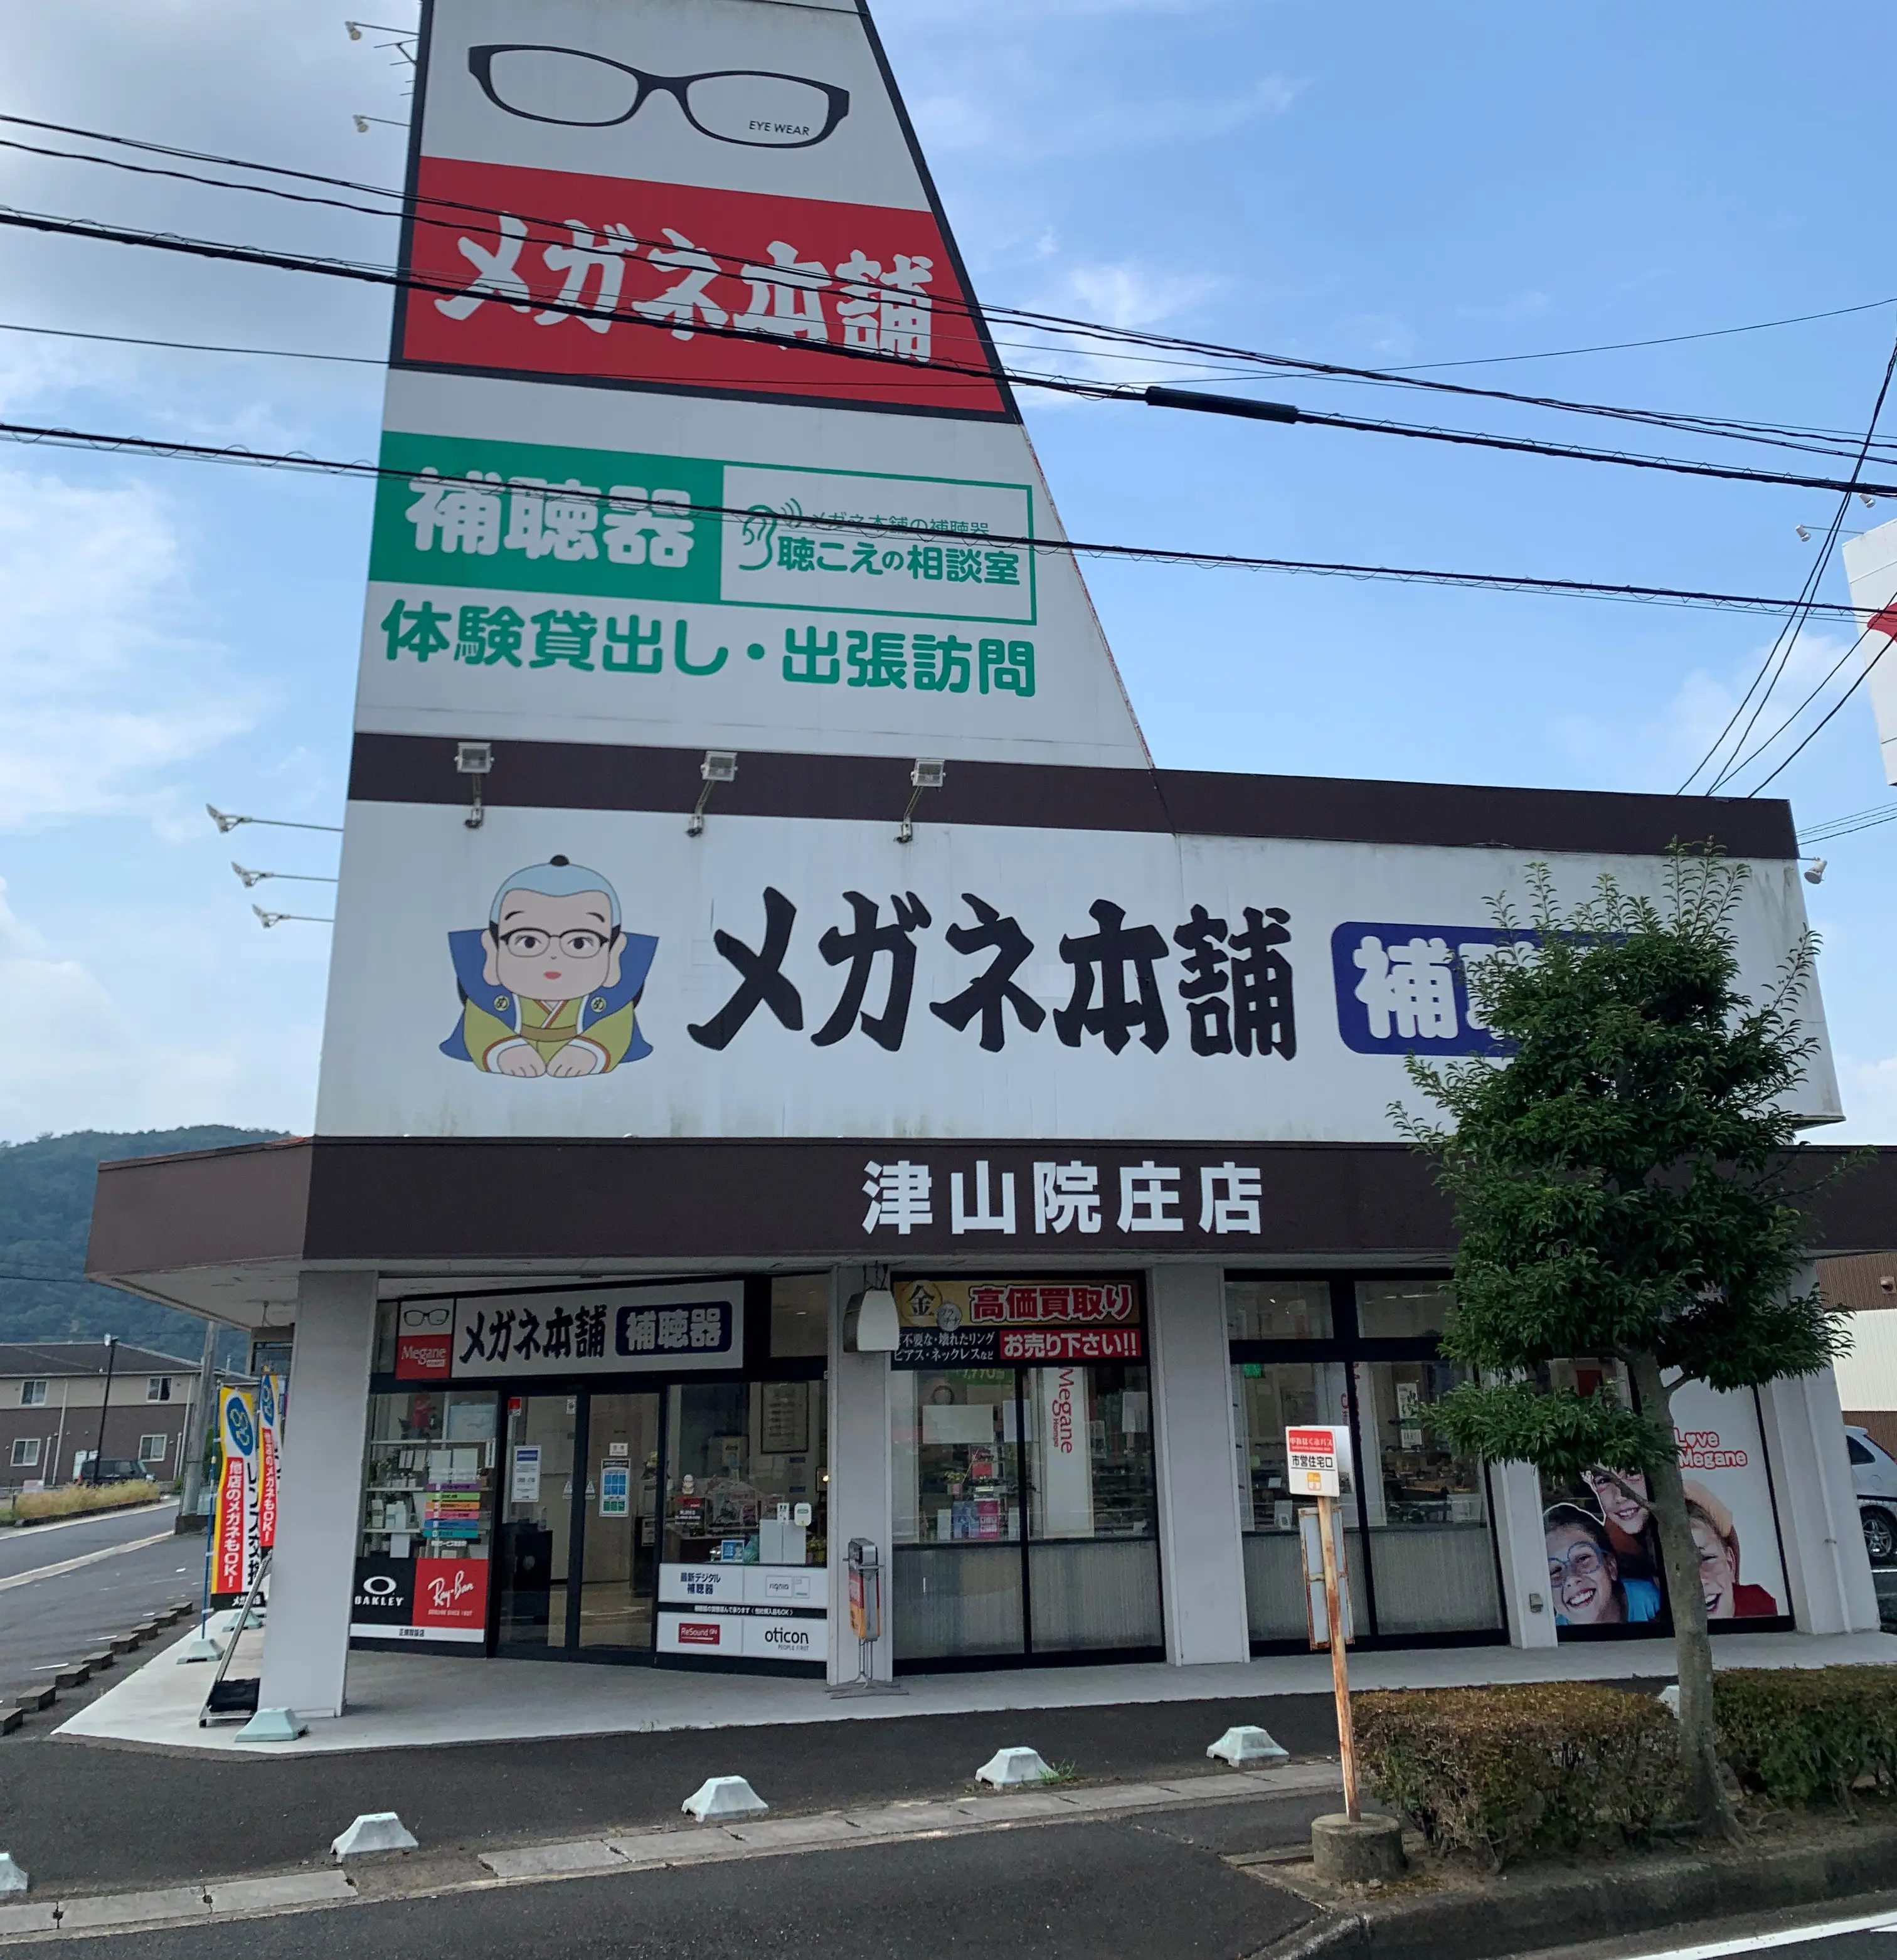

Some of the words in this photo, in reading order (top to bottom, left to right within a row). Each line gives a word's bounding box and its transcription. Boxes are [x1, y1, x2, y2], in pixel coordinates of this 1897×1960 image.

[749, 120, 771, 132] EYE
[774, 123, 810, 136] WEAR
[434, 211, 932, 363] メガネ本舗
[405, 467, 694, 568] 補聴器
[777, 534, 1020, 585] 聴こえの相談室
[380, 598, 1036, 697] 体験貸出し・出張訪問
[687, 887, 1297, 1061] メガネ本舗
[861, 1160, 1263, 1235] 津山院庄店
[908, 1284, 935, 1317] 金
[969, 1285, 1133, 1322] 高価買取り
[459, 1303, 608, 1364] メガネ本舗
[626, 1308, 722, 1350] 補聴器
[401, 1345, 447, 1365] Megane
[1051, 1369, 1075, 1454] Megane
[1292, 1455, 1334, 1468] 市営住宅口
[1677, 1448, 1748, 1469] Megane
[680, 1572, 721, 1583] 最新デジタル
[687, 1584, 713, 1595] 補聴器
[354, 1596, 405, 1607] OAKLEY
[681, 1627, 708, 1636] ReSound
[765, 1626, 809, 1644] oticon
